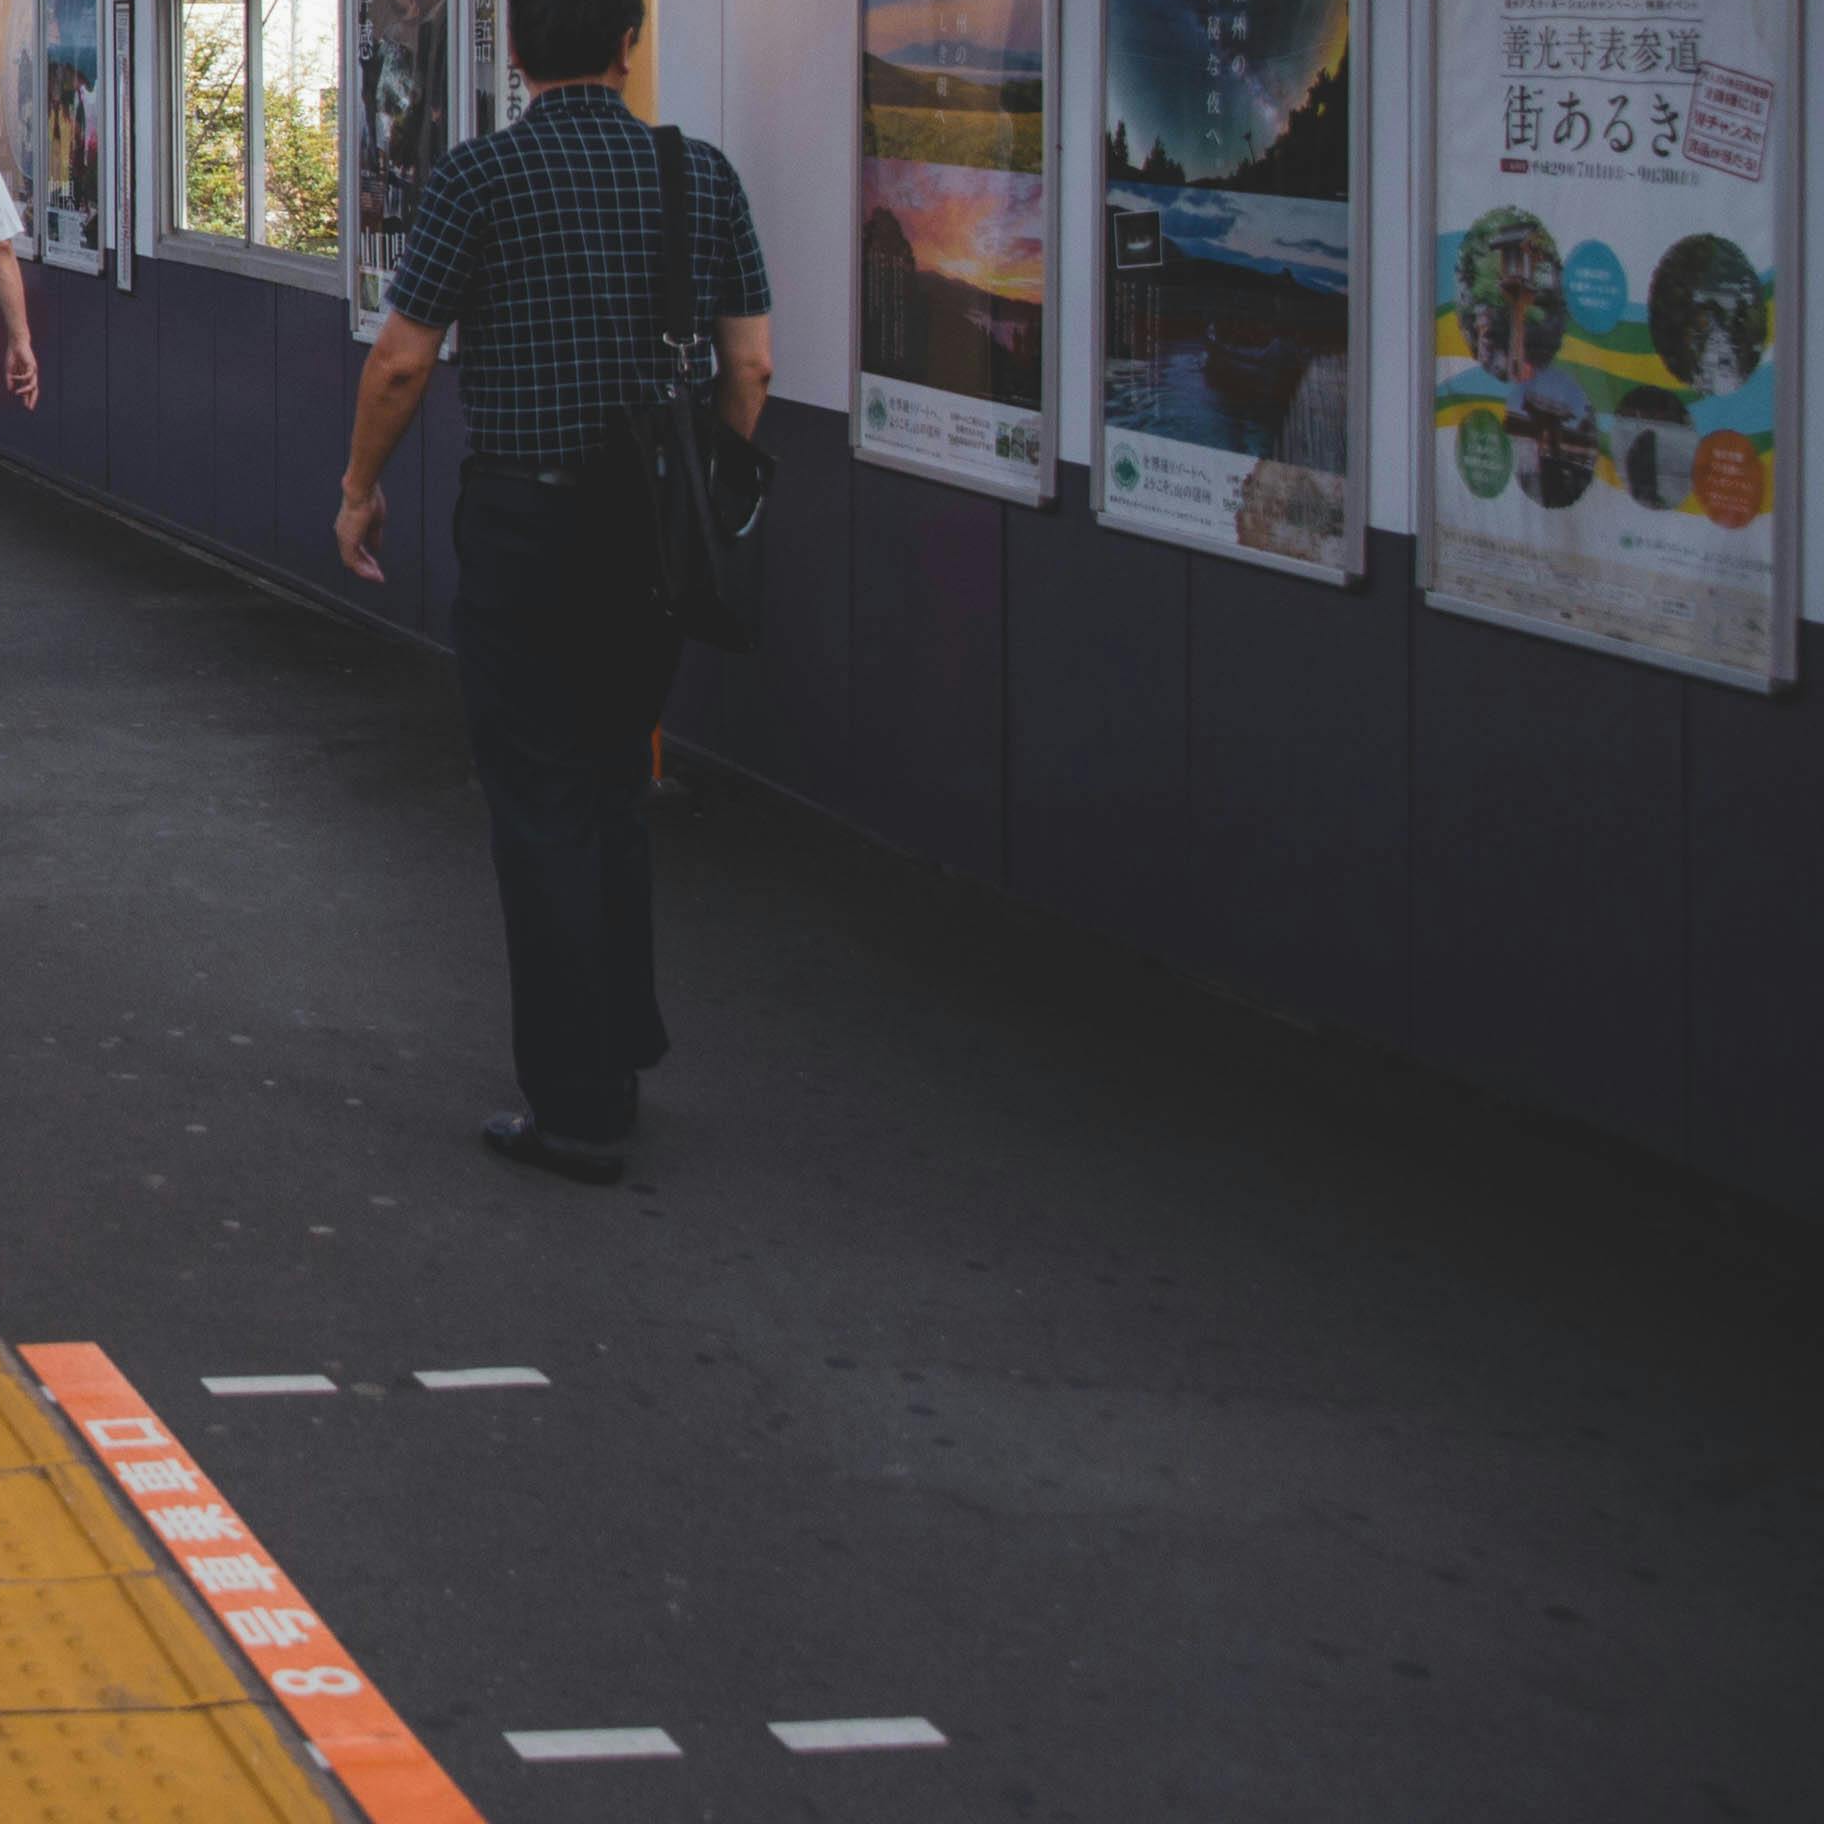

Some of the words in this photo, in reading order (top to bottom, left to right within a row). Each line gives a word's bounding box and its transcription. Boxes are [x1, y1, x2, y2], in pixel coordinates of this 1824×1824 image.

[1503, 25, 1702, 74] 善光寺表参道
[1503, 84, 1682, 158] 街あるき
[84, 1416, 362, 1694] 8号車乗車口
